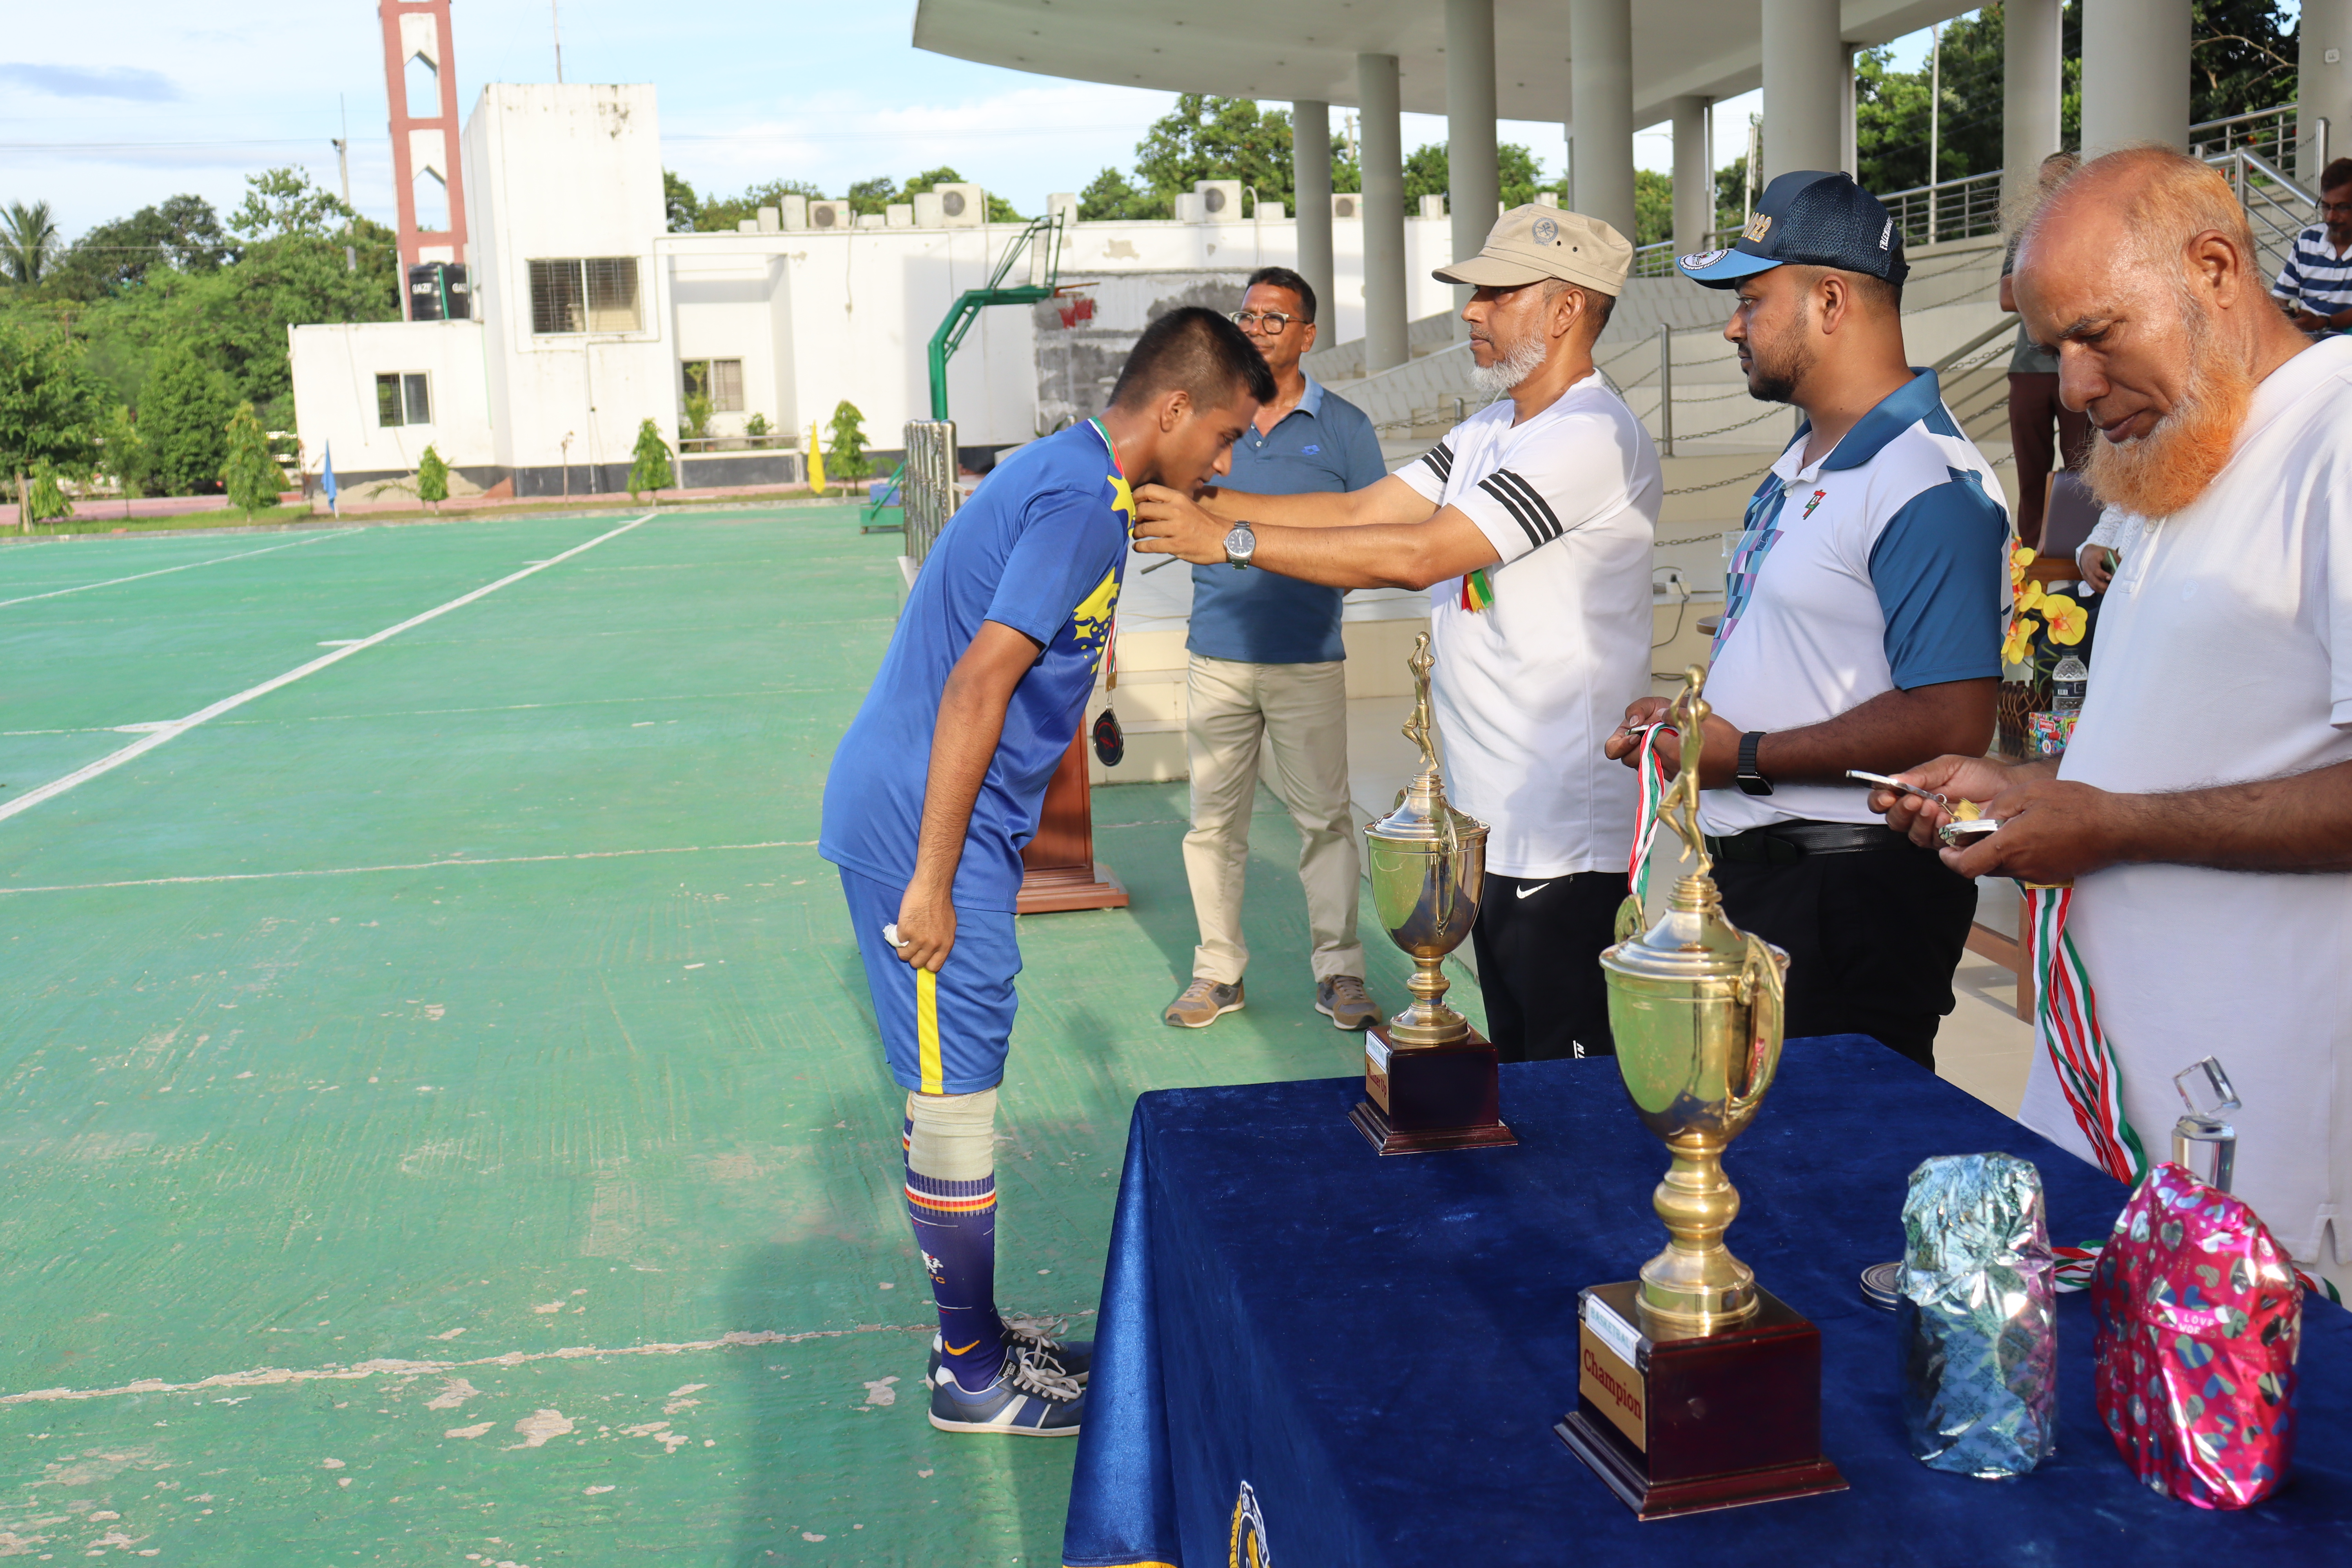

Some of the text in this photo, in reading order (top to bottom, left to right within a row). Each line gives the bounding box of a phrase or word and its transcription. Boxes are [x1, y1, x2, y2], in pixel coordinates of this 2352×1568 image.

[1367, 1063, 1387, 1098] Runner Up
[1002, 1361, 1013, 1377] NORTH
[1584, 1349, 1642, 1421] Champion
